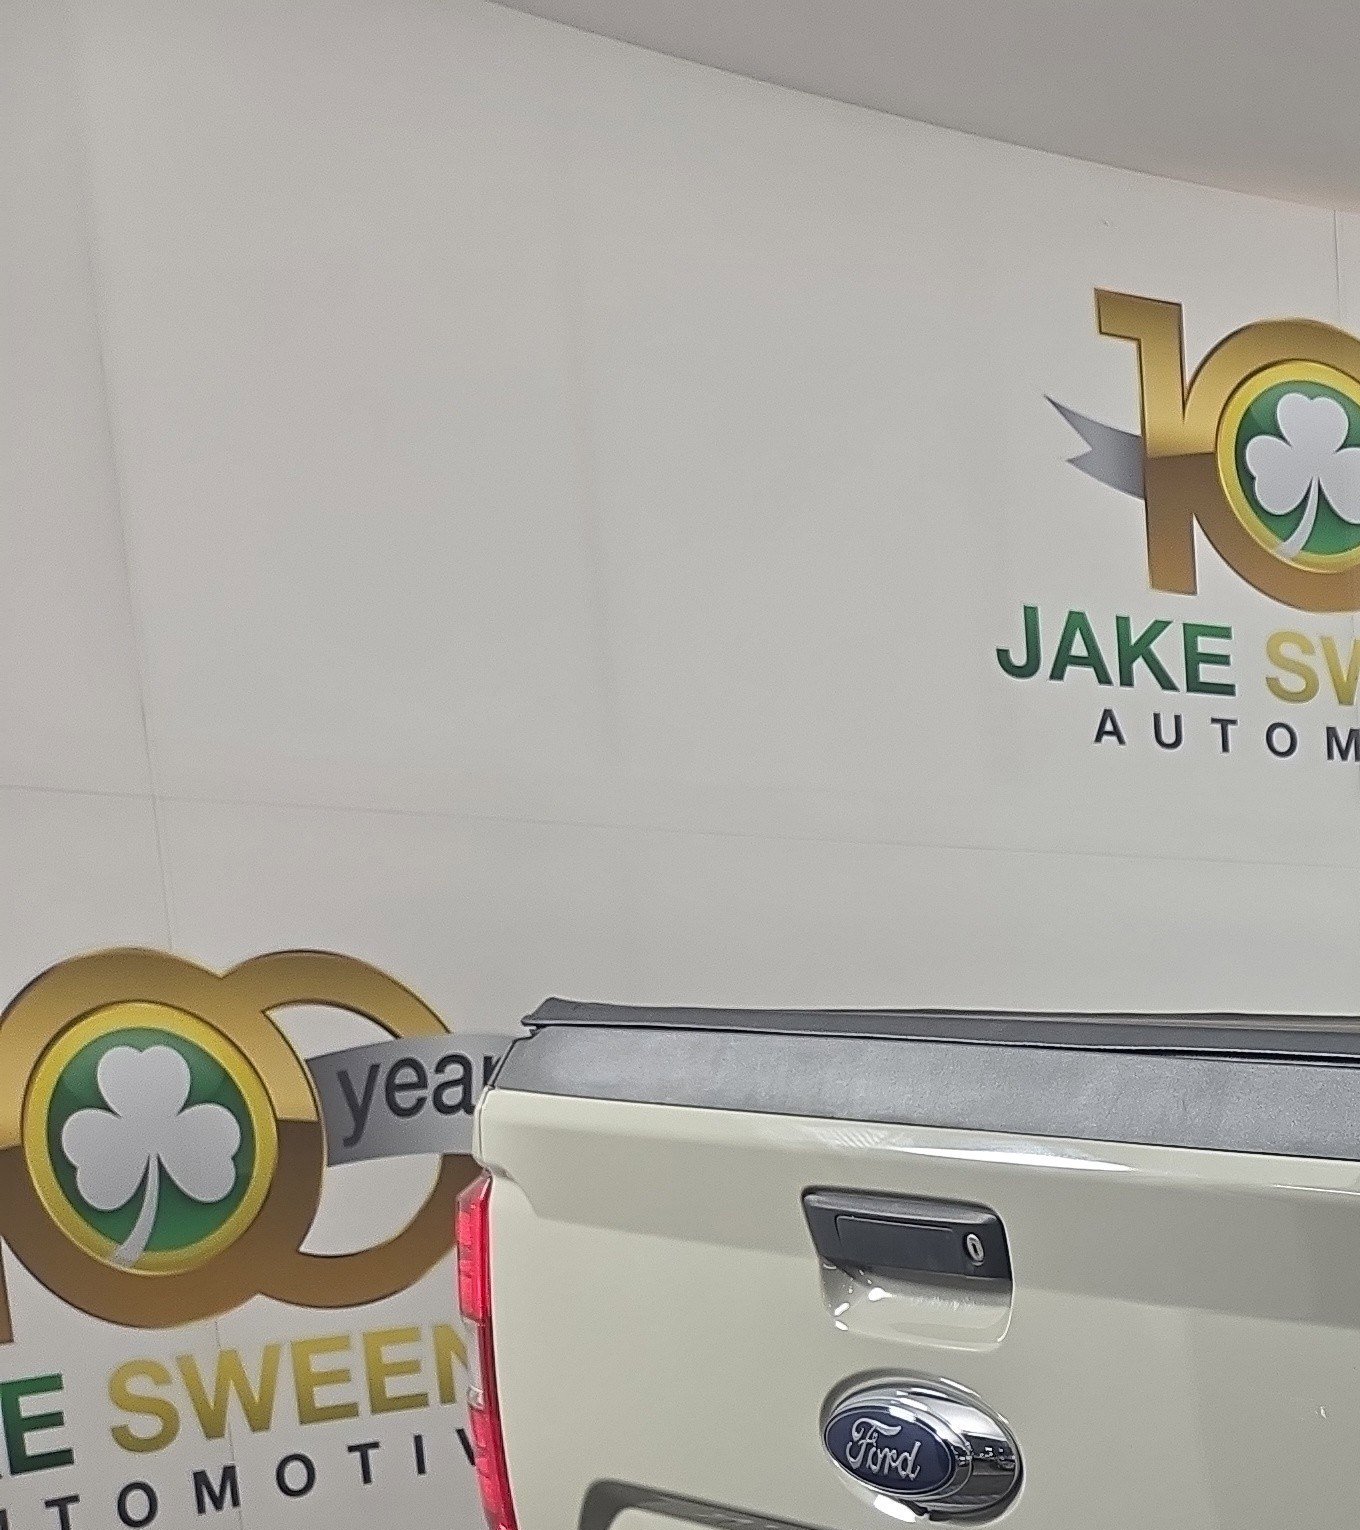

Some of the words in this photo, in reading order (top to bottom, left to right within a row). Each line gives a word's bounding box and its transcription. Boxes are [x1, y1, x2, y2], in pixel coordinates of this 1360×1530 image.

[995, 604, 1237, 698] JAKE
[0, 946, 475, 1329] 00
[336, 1052, 502, 1148] yea
[107, 1323, 470, 1454] SWEEN
[844, 1417, 922, 1481] Ford
